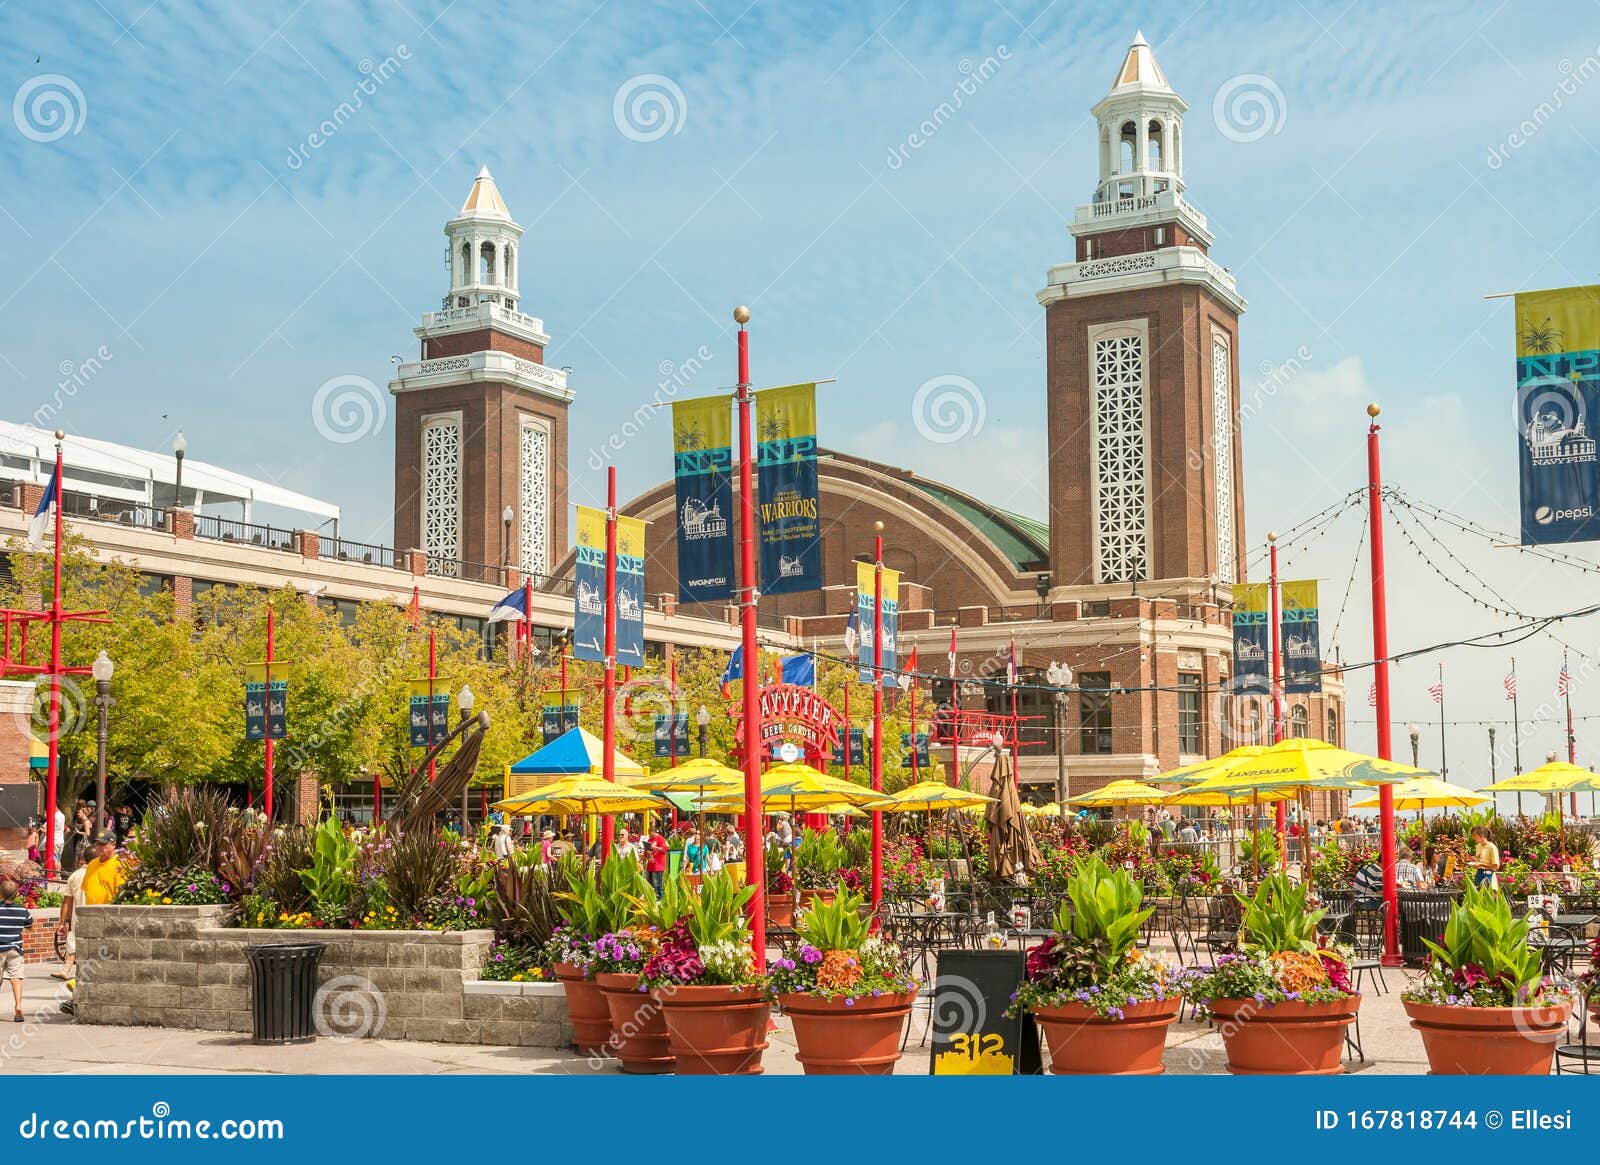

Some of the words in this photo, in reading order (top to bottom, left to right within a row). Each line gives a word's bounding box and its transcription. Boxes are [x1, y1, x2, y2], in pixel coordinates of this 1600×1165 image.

[677, 449, 731, 477] NP
[759, 437, 815, 467] NP
[761, 497, 817, 525] WARRIORS
[1556, 505, 1592, 521] pepsi
[761, 692, 831, 725] AVYPIER
[1530, 896, 1541, 905] 26
[948, 1032, 1004, 1058] 312
